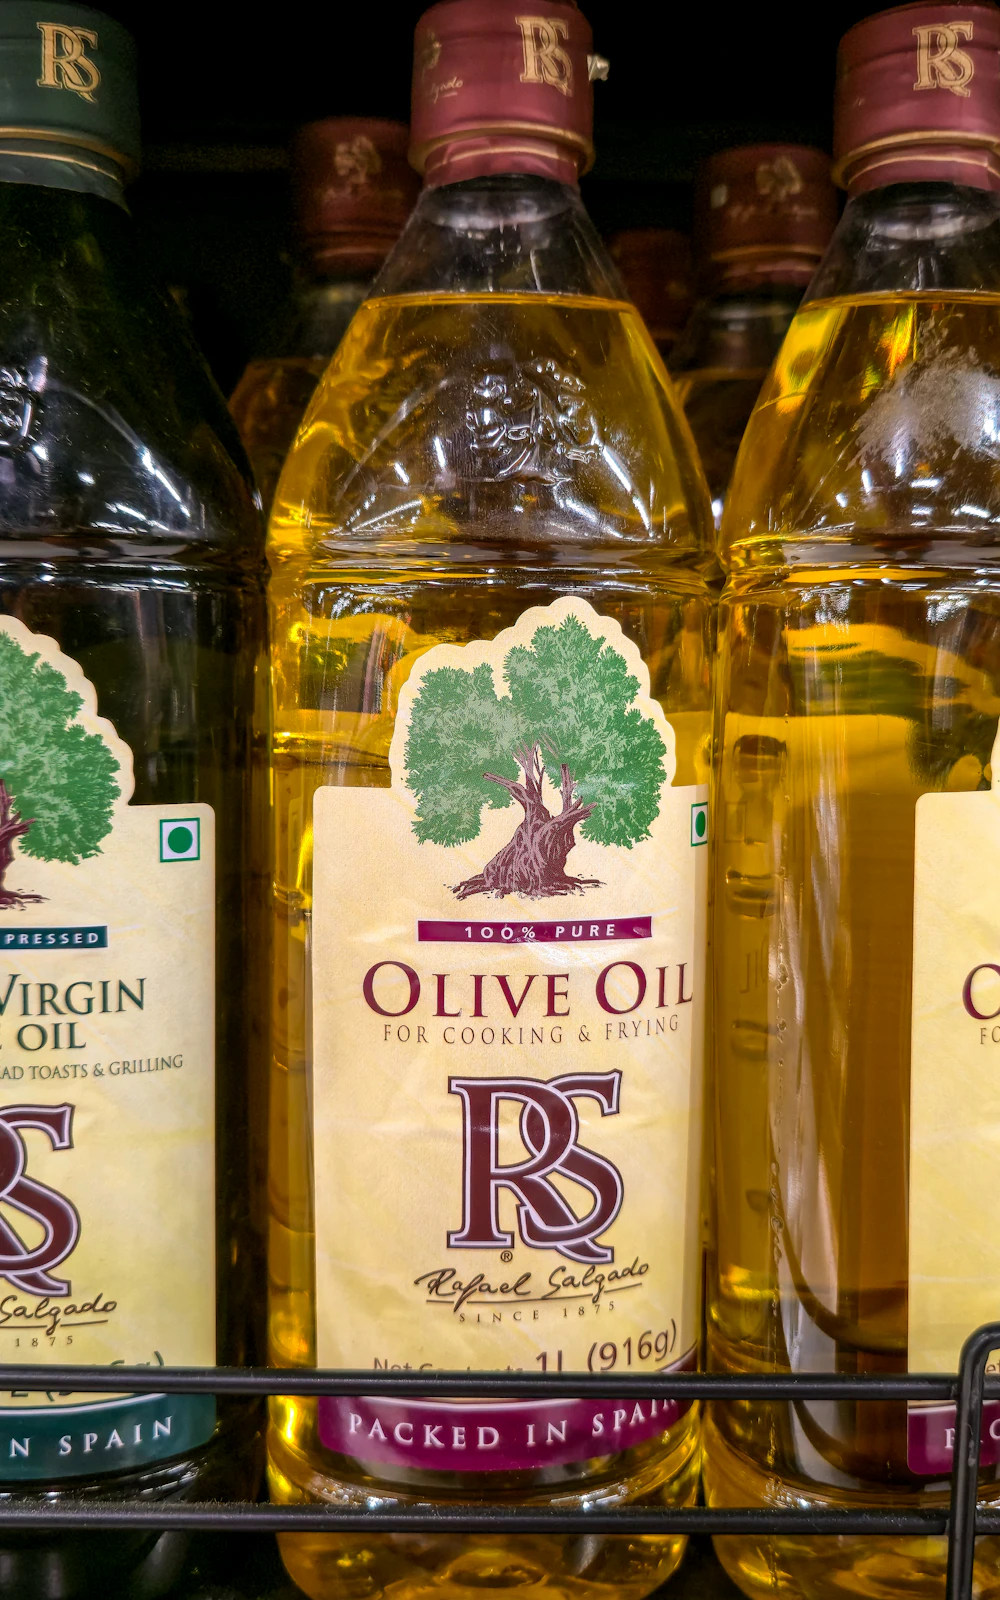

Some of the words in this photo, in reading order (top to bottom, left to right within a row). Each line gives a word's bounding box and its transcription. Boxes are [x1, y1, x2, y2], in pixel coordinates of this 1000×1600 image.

[37, 21, 101, 103] RS
[515, 16, 573, 97] RS
[912, 21, 974, 98] RS
[6, 932, 99, 945] PRESSED
[464, 925, 536, 941] 100%
[555, 923, 616, 938] PURE
[0, 973, 147, 1016] VIRGIN
[362, 960, 571, 1018] OLIVE
[596, 960, 694, 1015] OIL
[17, 1022, 87, 1051] OIL
[383, 1024, 429, 1044] FOR
[443, 1026, 563, 1046] COOKING
[578, 1025, 592, 1042] &
[605, 1014, 679, 1041] FRYING
[0, 1065, 25, 1080] AD
[29, 1063, 88, 1080] TOASTS
[93, 1062, 105, 1077] &
[109, 1054, 183, 1076] GRILLING
[447, 1068, 624, 1264] RS
[413, 1267, 532, 1313] Rafael
[540, 1256, 650, 1303] Salgado
[0, 1293, 118, 1336] Salgado
[459, 1309, 540, 1324] SINCE
[563, 1301, 615, 1318] 1875
[15, 1334, 74, 1347] 1875
[587, 1318, 677, 1371] (916g)
[59, 1415, 173, 1456] SPAIN
[350, 1412, 499, 1448] PACKED
[526, 1419, 568, 1447] IN
